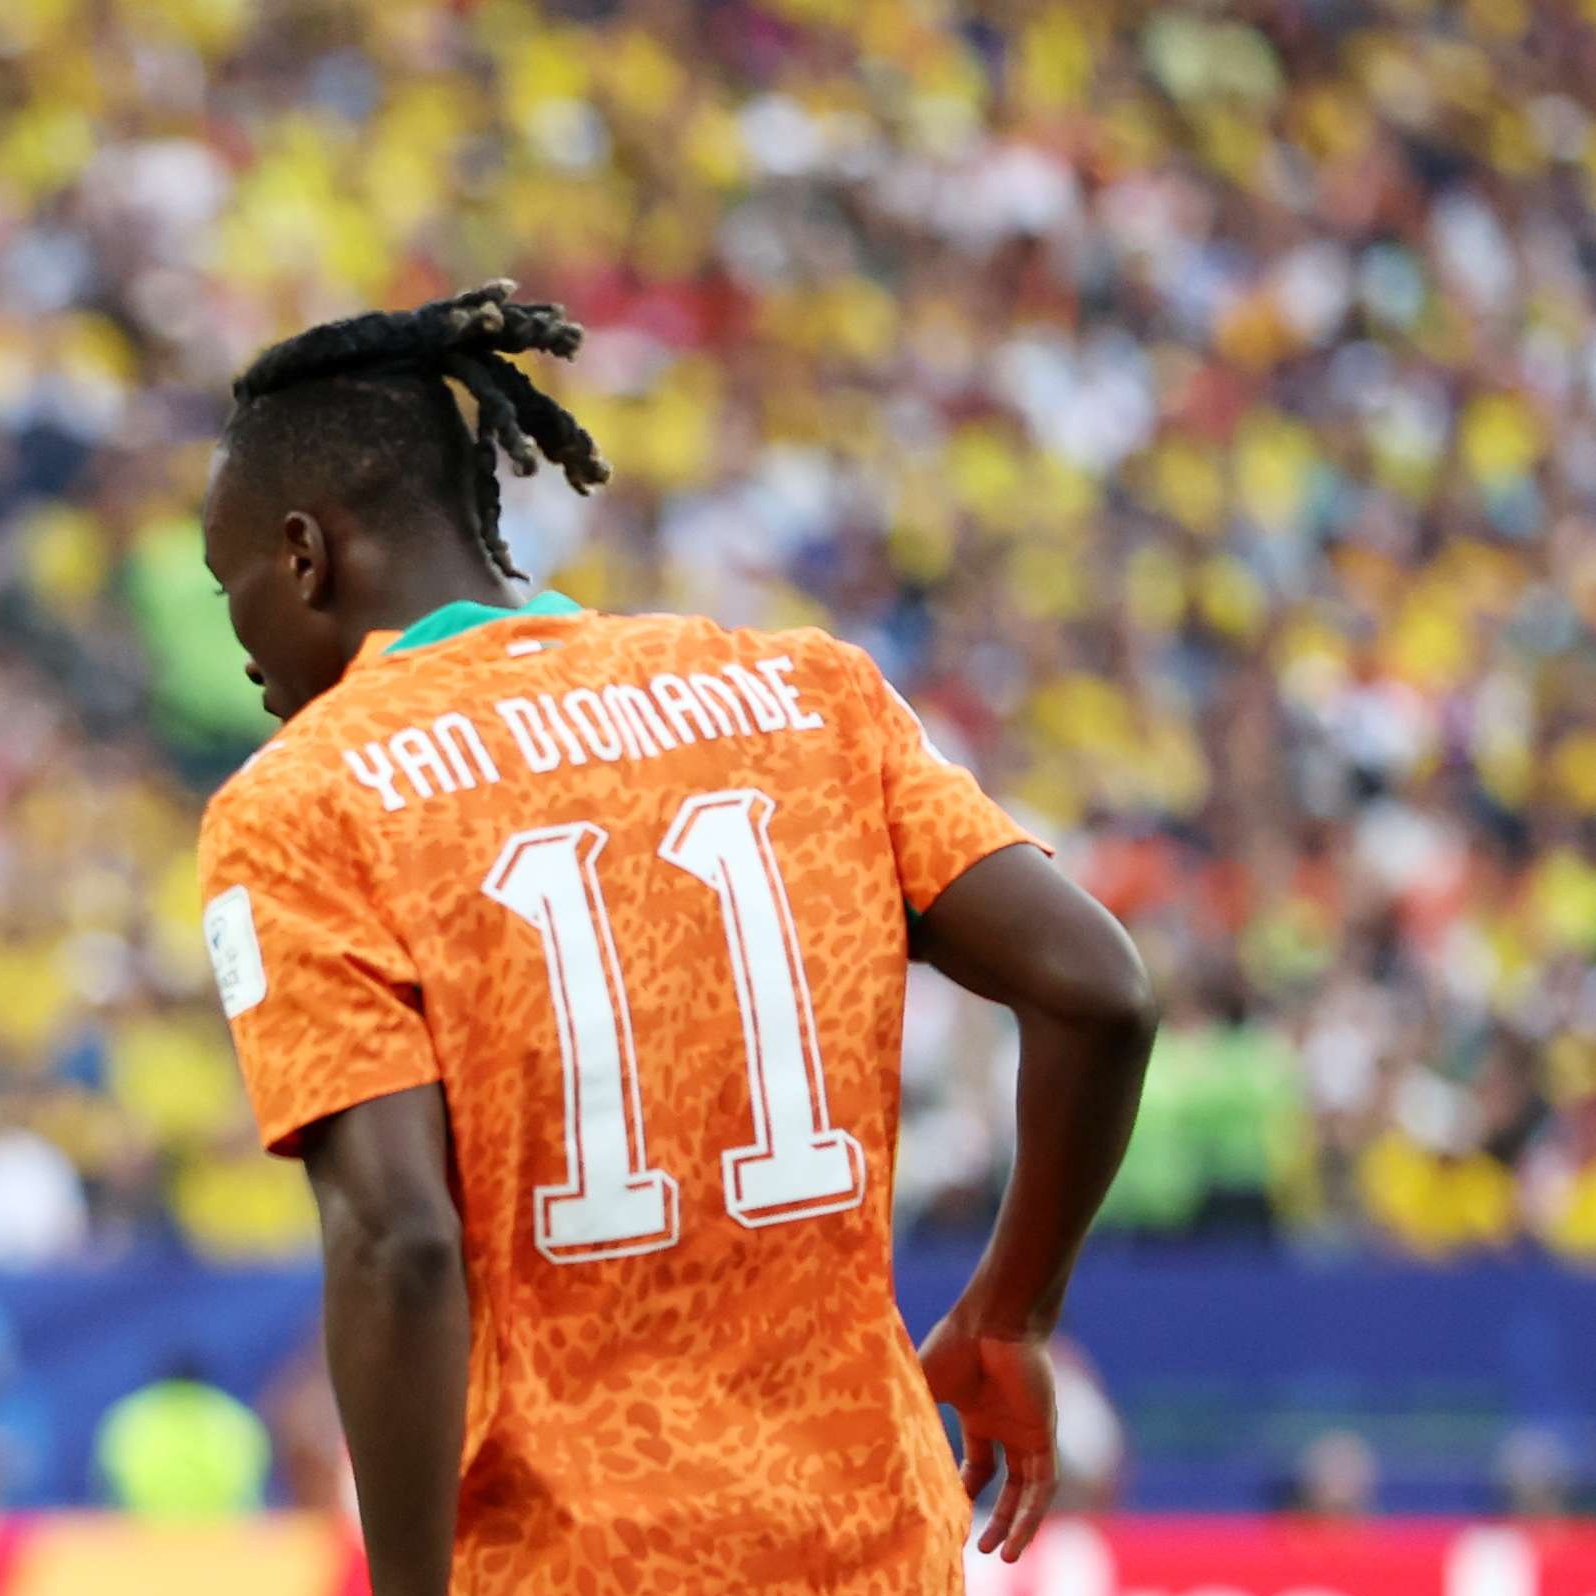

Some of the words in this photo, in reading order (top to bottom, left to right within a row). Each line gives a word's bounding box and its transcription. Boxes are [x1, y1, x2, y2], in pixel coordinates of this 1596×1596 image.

[343, 712, 500, 812] YAN
[496, 656, 824, 773] DIOMANDE
[483, 787, 865, 1264] 11
